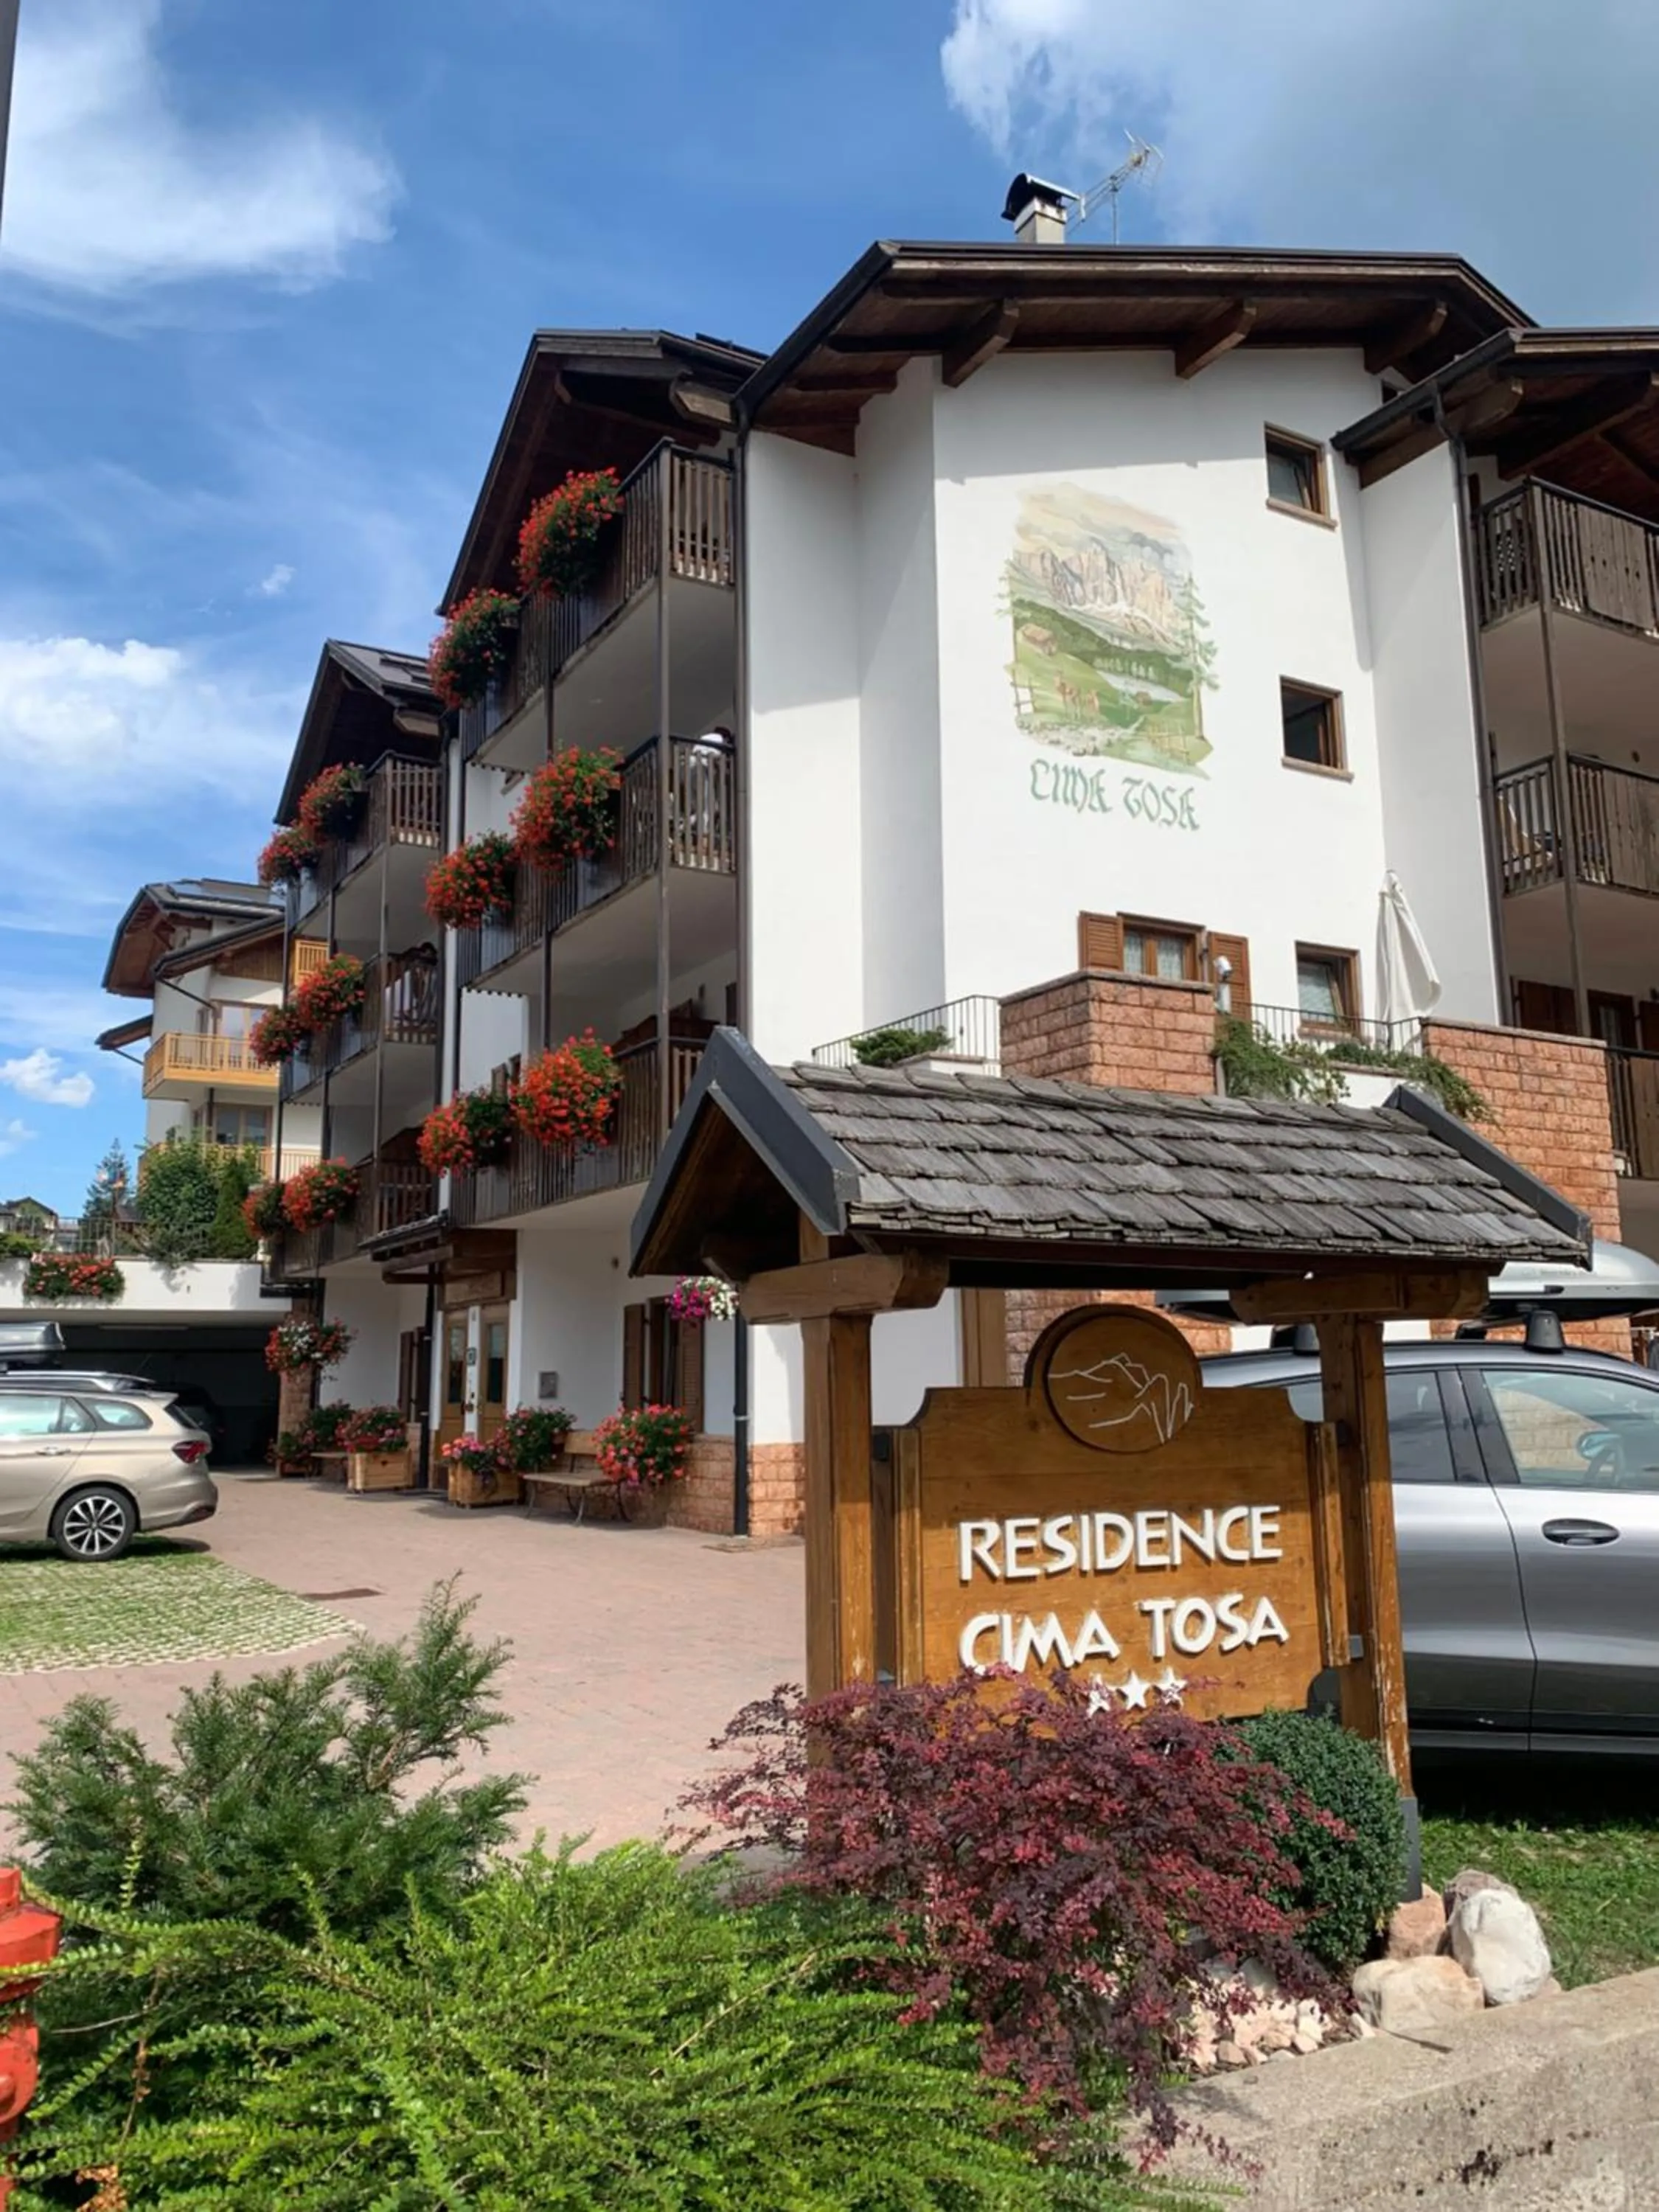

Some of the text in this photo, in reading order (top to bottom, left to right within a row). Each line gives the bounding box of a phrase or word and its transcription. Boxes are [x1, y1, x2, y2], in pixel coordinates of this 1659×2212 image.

[1121, 776, 1200, 831] TOSA
[959, 1506, 1283, 1582] RESIDENCE
[960, 1593, 1290, 1675] CIMA TOSA
